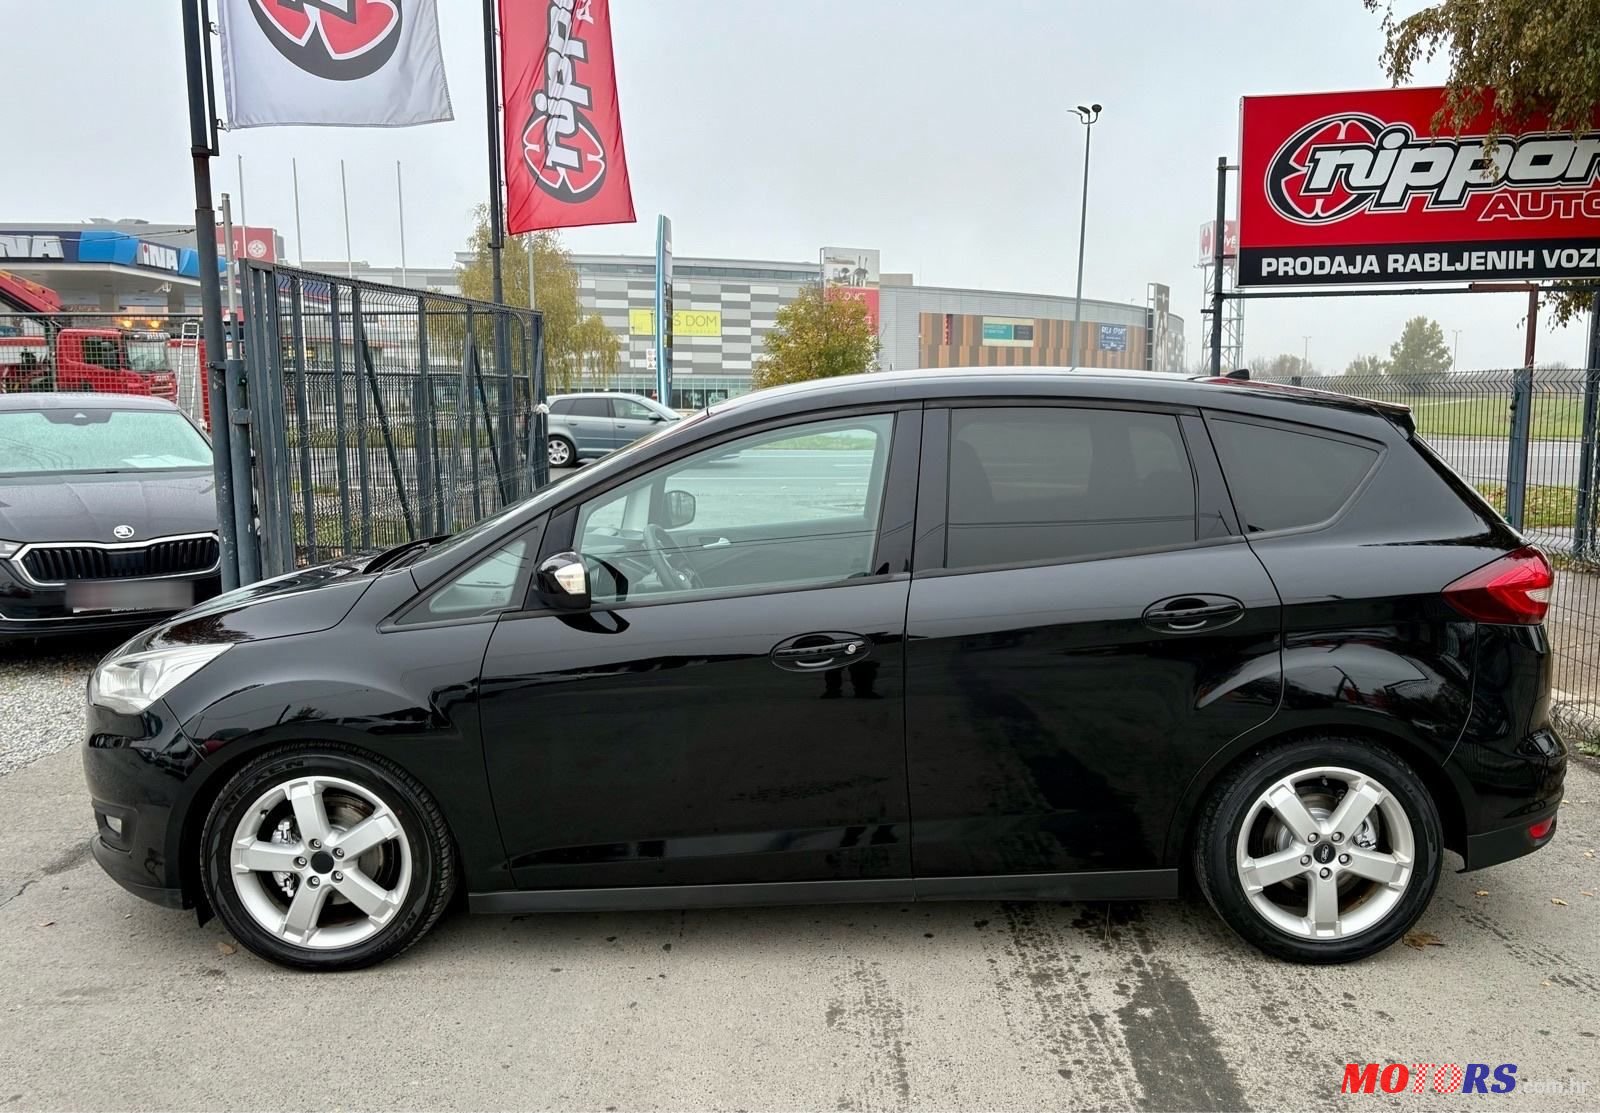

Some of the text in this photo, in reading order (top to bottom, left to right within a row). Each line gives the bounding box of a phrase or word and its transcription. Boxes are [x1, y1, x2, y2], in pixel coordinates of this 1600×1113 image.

[1261, 254, 1380, 277] PRODAJA
[1387, 249, 1535, 274] RABLJENIH
[685, 314, 717, 328] DOM
